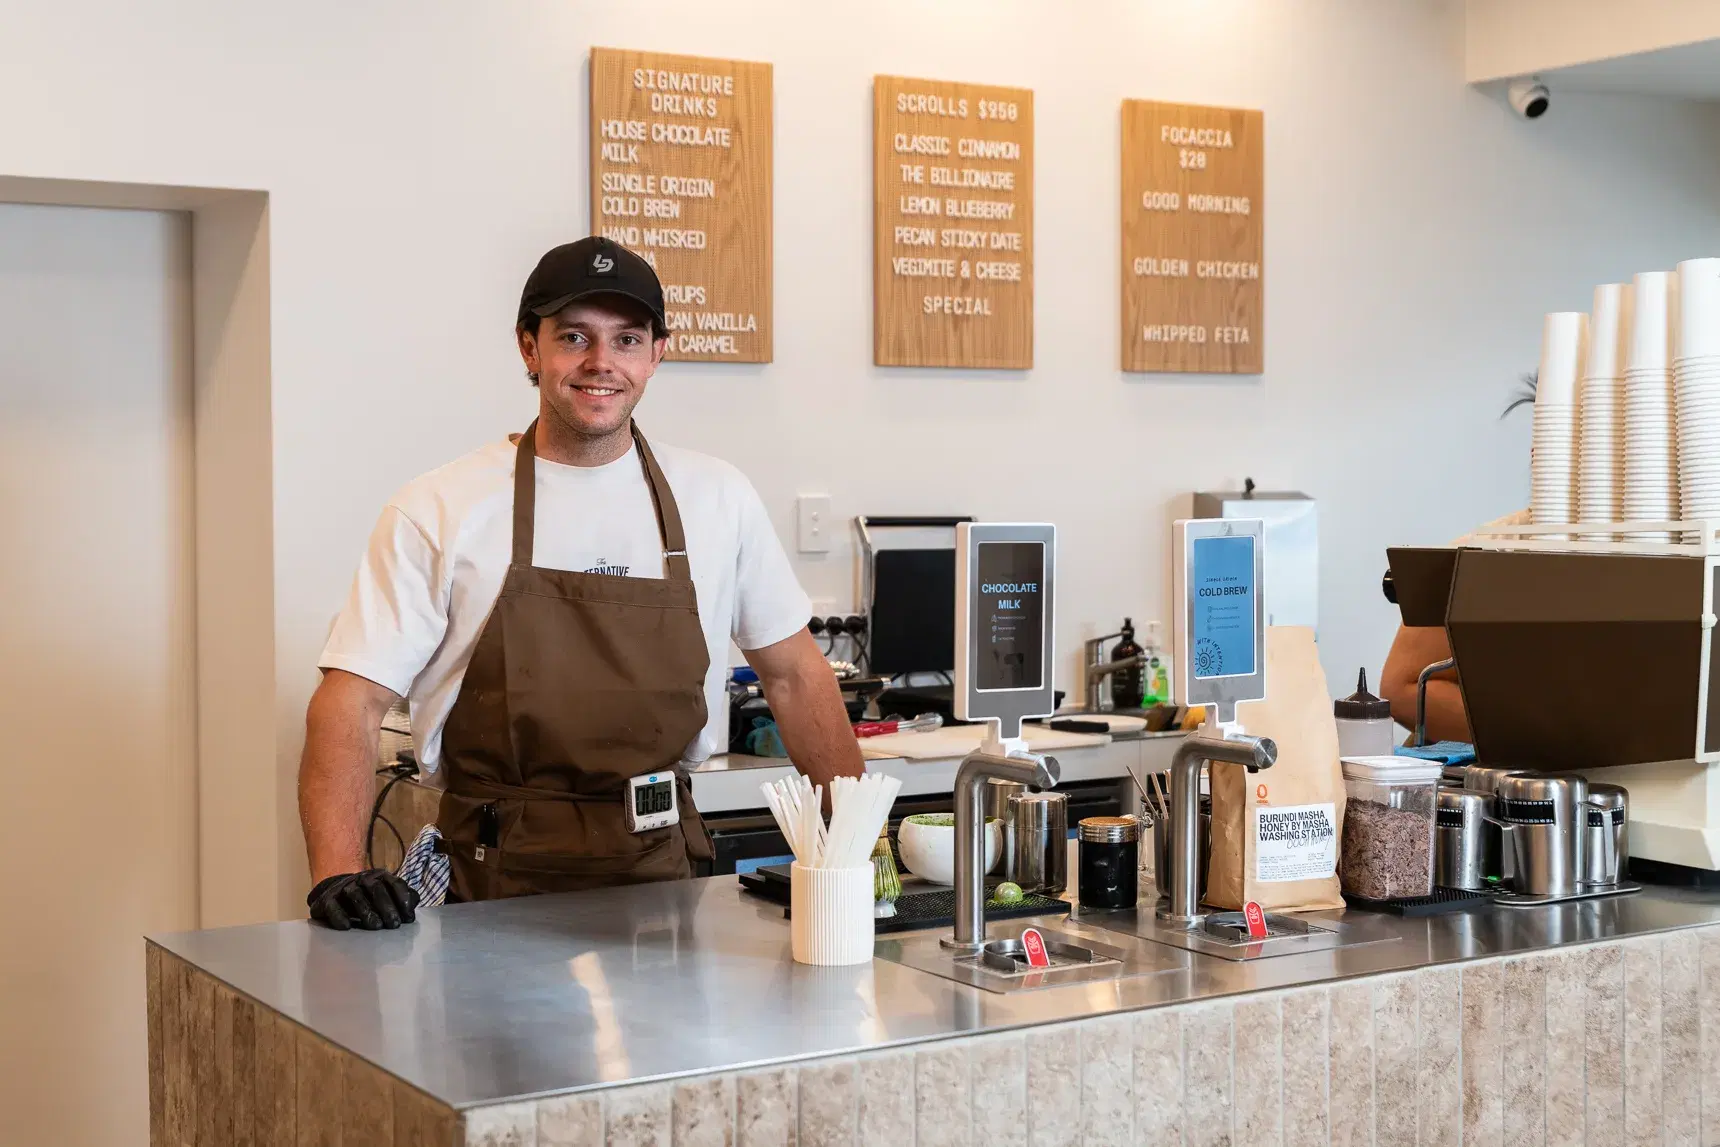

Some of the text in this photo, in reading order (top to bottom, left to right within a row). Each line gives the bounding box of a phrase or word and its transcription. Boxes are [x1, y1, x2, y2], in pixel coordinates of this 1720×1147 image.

[633, 68, 734, 96] SIGNATURE
[651, 93, 717, 118] DRINKS
[896, 92, 968, 117] SCROLLS
[601, 119, 731, 148] HOUSE CHOCOLATE
[1161, 125, 1233, 148] FOCACCIA
[601, 142, 638, 163] MILK
[894, 133, 1020, 160] CLASSIC CINNAMON
[601, 172, 715, 198] SINGLE ORIGIN
[900, 164, 1015, 190] THE BILLIONAIRE
[601, 195, 680, 219] COLD BREW
[900, 195, 1016, 220] LEMON BLUEBERRY
[1142, 190, 1250, 216] GOOD MORNING
[643, 229, 706, 250] WHISKED
[894, 226, 1022, 252] PECAN STICKY DATE
[892, 257, 1022, 282] VEGIMITE & CHEESE
[1134, 256, 1259, 280] GOLDEN CHICKEN
[661, 284, 706, 306] YRUPS
[923, 295, 993, 317] SPECIAL
[695, 312, 757, 333] VANILLA
[678, 334, 739, 355] CARAMEL
[1143, 325, 1250, 345] WHIPPED FETA
[981, 583, 1037, 594] CHOCOLATE
[1199, 586, 1248, 597] COLD BREW
[998, 599, 1021, 610] MILK
[1259, 810, 1325, 823] BURUNDI MASHA
[1259, 819, 1330, 832] HONEY BY MASHA
[1259, 827, 1333, 841] WASHING STATION
